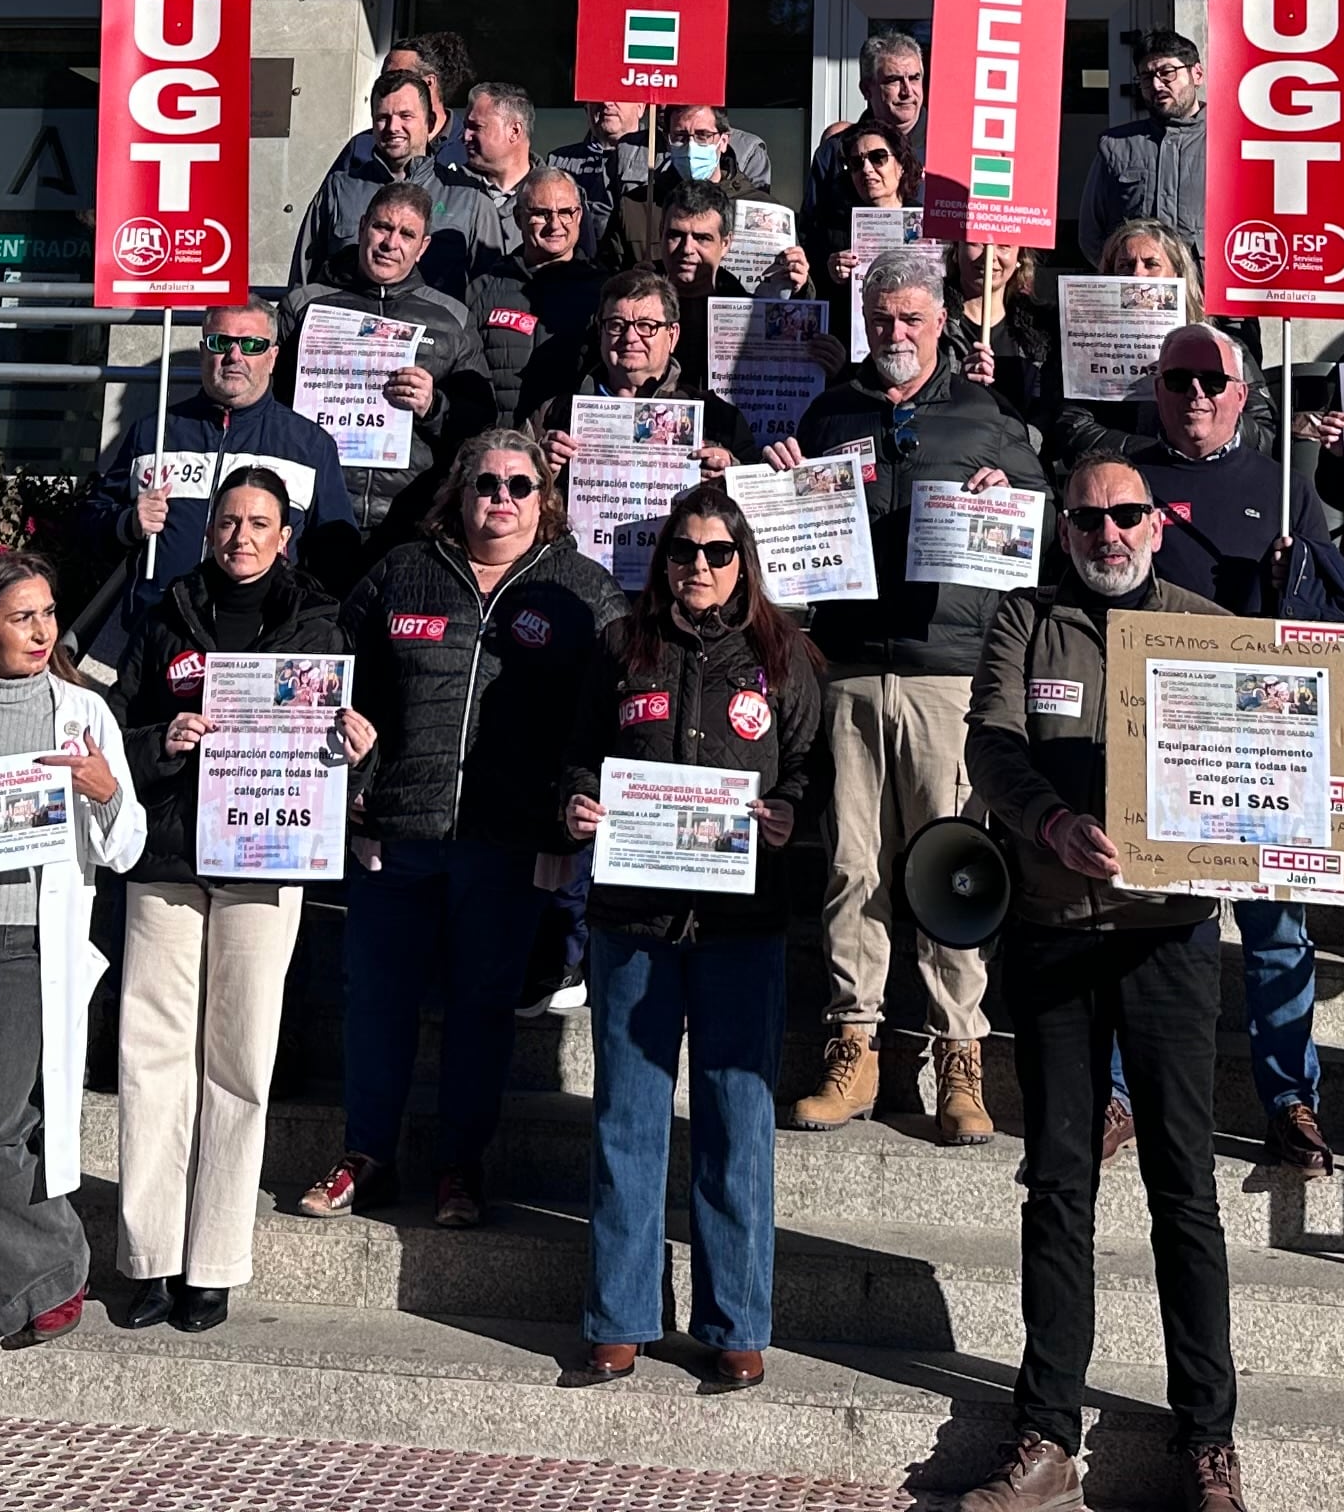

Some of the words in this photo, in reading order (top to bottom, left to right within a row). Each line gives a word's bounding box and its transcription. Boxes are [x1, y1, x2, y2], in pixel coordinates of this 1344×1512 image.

[621, 67, 678, 89] Jaén
[990, 204, 1001, 212] DE
[1004, 205, 1040, 215] SANIDAD
[121, 227, 162, 249] UGT
[175, 229, 206, 246] FSP
[1235, 231, 1278, 255] UGT
[1293, 234, 1327, 252] FSP
[149, 282, 195, 291] Andalucía
[1266, 290, 1316, 301] Andalucía
[489, 310, 520, 325] UGT
[300, 367, 349, 376] Equiparación
[1091, 364, 1107, 374] En
[1113, 365, 1124, 374] el
[345, 382, 362, 391] para
[324, 396, 364, 405] categorías
[317, 413, 333, 426] En
[339, 413, 351, 426] el
[357, 414, 385, 427] SAS
[767, 420, 795, 434] SAS
[573, 477, 627, 488] Equiparación
[630, 481, 687, 492] complemento
[577, 494, 619, 504] específico
[622, 496, 641, 505] para
[644, 496, 667, 505] todas
[599, 511, 644, 521] categorías
[798, 517, 856, 529] complemento
[594, 530, 611, 544] En
[618, 531, 632, 545] el
[771, 543, 816, 555] categorías
[768, 562, 786, 573] En
[792, 559, 806, 570] el
[811, 554, 842, 568] SAS
[391, 617, 428, 635] UGT
[519, 609, 550, 638] UGT
[169, 653, 201, 679] UGT
[619, 699, 647, 725] UGT
[733, 694, 768, 721] UGT
[205, 748, 266, 761] Equiparación
[1158, 740, 1231, 754] Equiparación
[1235, 745, 1313, 758] complemento
[1164, 757, 1222, 771] específico
[1226, 760, 1251, 771] para
[1255, 761, 1286, 772] todas
[1290, 762, 1307, 773] las
[209, 767, 257, 778] específico
[261, 769, 282, 778] para
[285, 768, 311, 778] todas
[315, 768, 328, 778] las
[1196, 772, 1256, 786] categorías
[235, 786, 284, 797] categorías
[622, 791, 660, 801] PERSONAL
[663, 794, 673, 802] DE
[675, 795, 739, 805] MANTENIMIENTO
[1189, 791, 1215, 807] En
[1222, 792, 1240, 808] el
[1247, 794, 1289, 810] SAS
[228, 808, 248, 825] En
[255, 808, 269, 825] el
[276, 809, 311, 826] SAS
[1264, 850, 1324, 872] CCOO
[1286, 872, 1316, 885] Jaén
